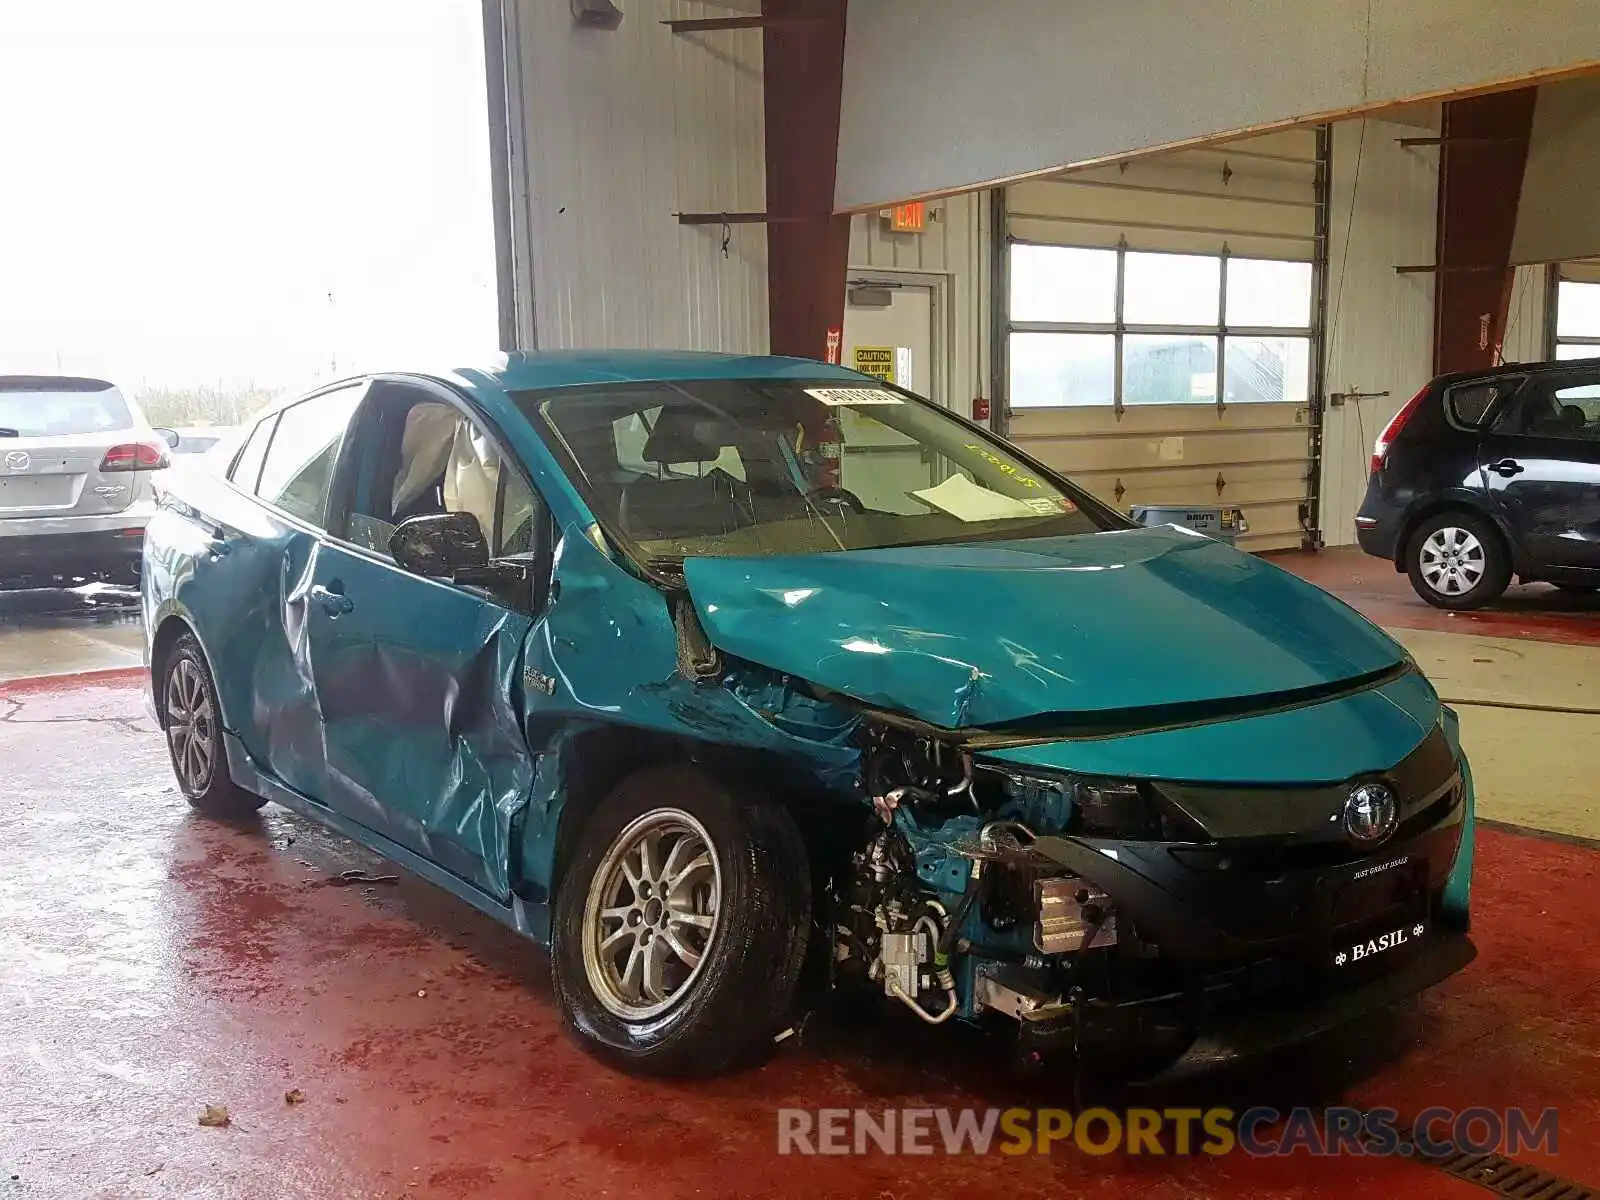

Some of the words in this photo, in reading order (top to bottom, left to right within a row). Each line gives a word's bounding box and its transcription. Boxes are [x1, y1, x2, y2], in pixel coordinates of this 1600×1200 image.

[857, 351, 890, 361] CAUTION
[1353, 869, 1370, 879] JUST
[1351, 929, 1408, 961] BASIL
